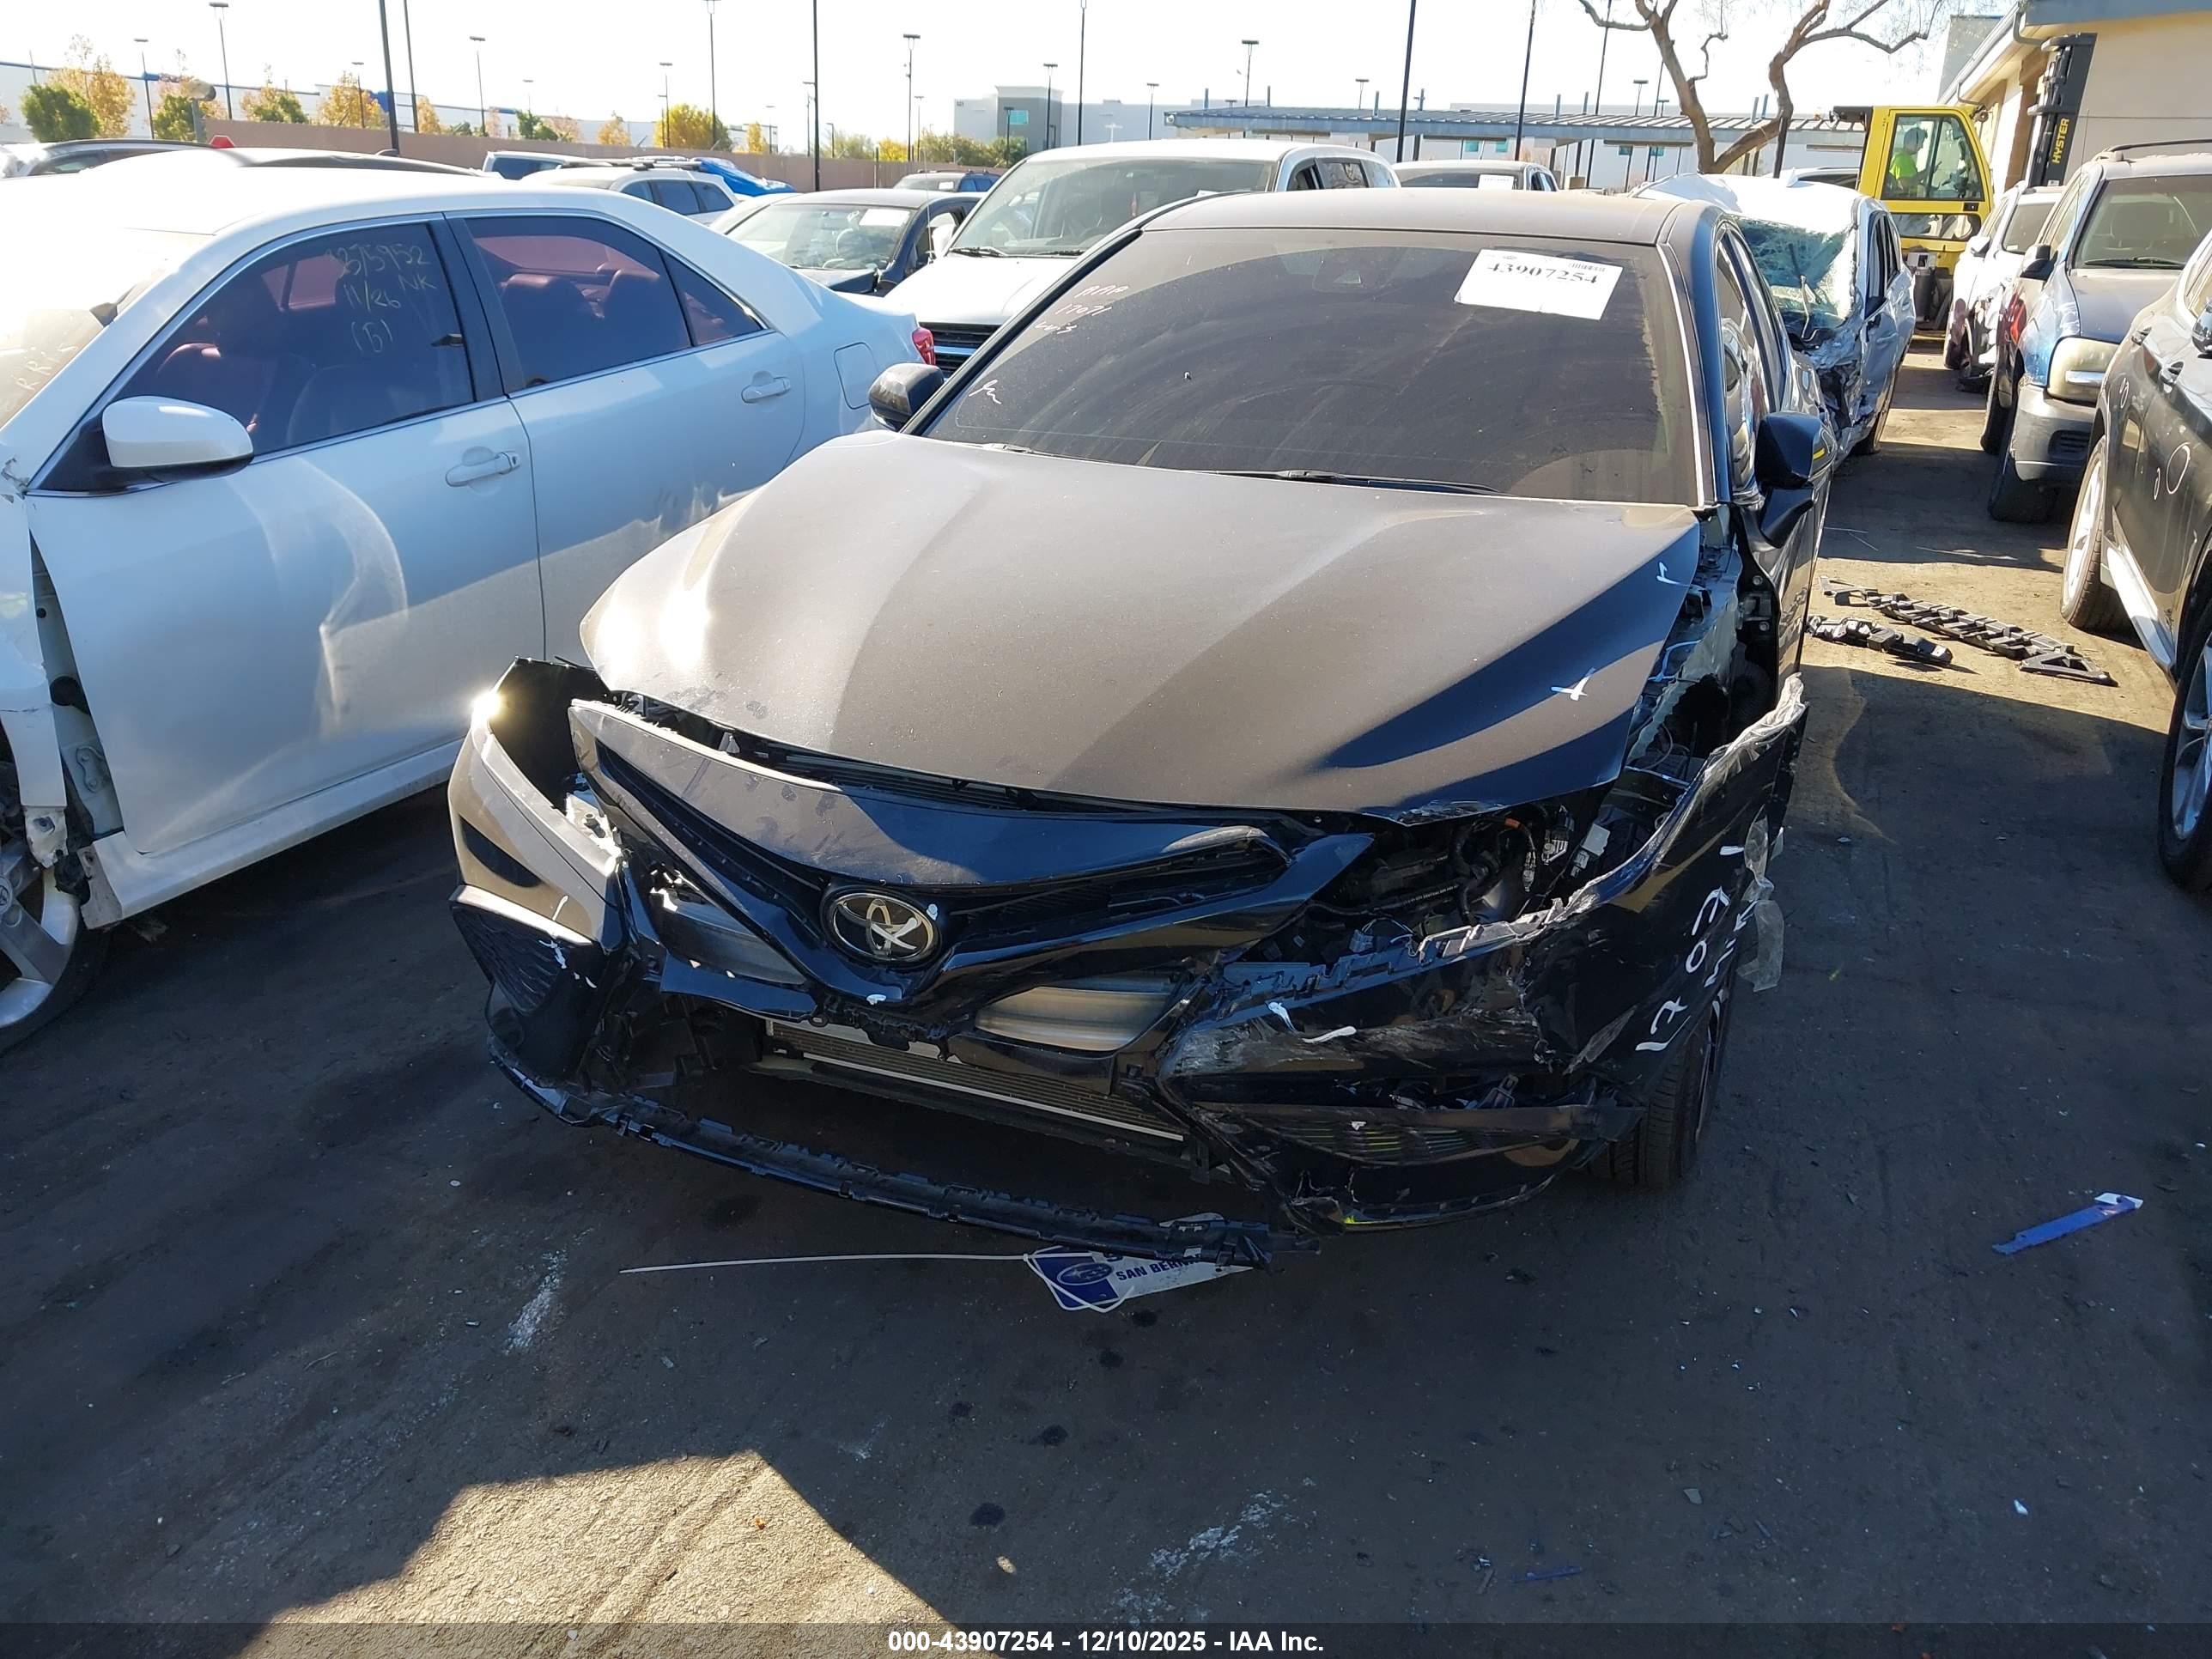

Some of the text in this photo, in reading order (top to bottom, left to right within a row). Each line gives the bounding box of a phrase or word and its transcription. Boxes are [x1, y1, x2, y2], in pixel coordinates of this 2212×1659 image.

[2051, 118, 2070, 164] HYSTER
[1486, 262, 1598, 284] 43907254
[1116, 1267, 1149, 1281] SAN
